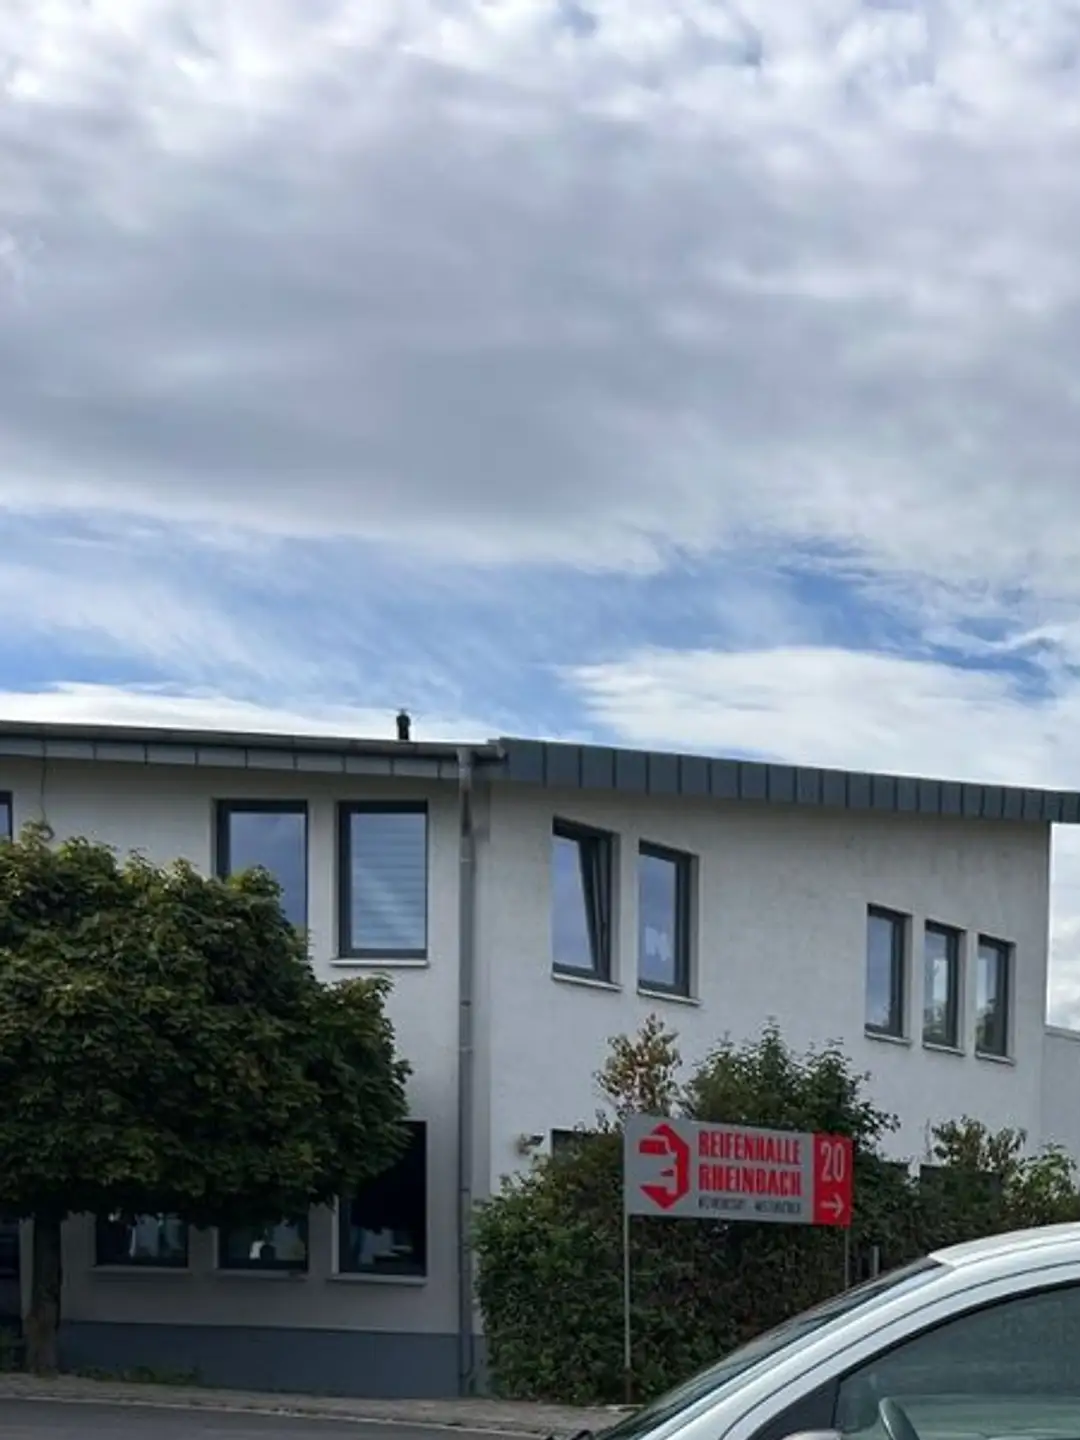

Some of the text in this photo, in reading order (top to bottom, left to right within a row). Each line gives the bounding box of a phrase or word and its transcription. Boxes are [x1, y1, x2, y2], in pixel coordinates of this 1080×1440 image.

[698, 1130, 803, 1165] REIFENHALLE
[820, 1140, 846, 1183] 20
[698, 1163, 803, 1197] RHEINBACH
